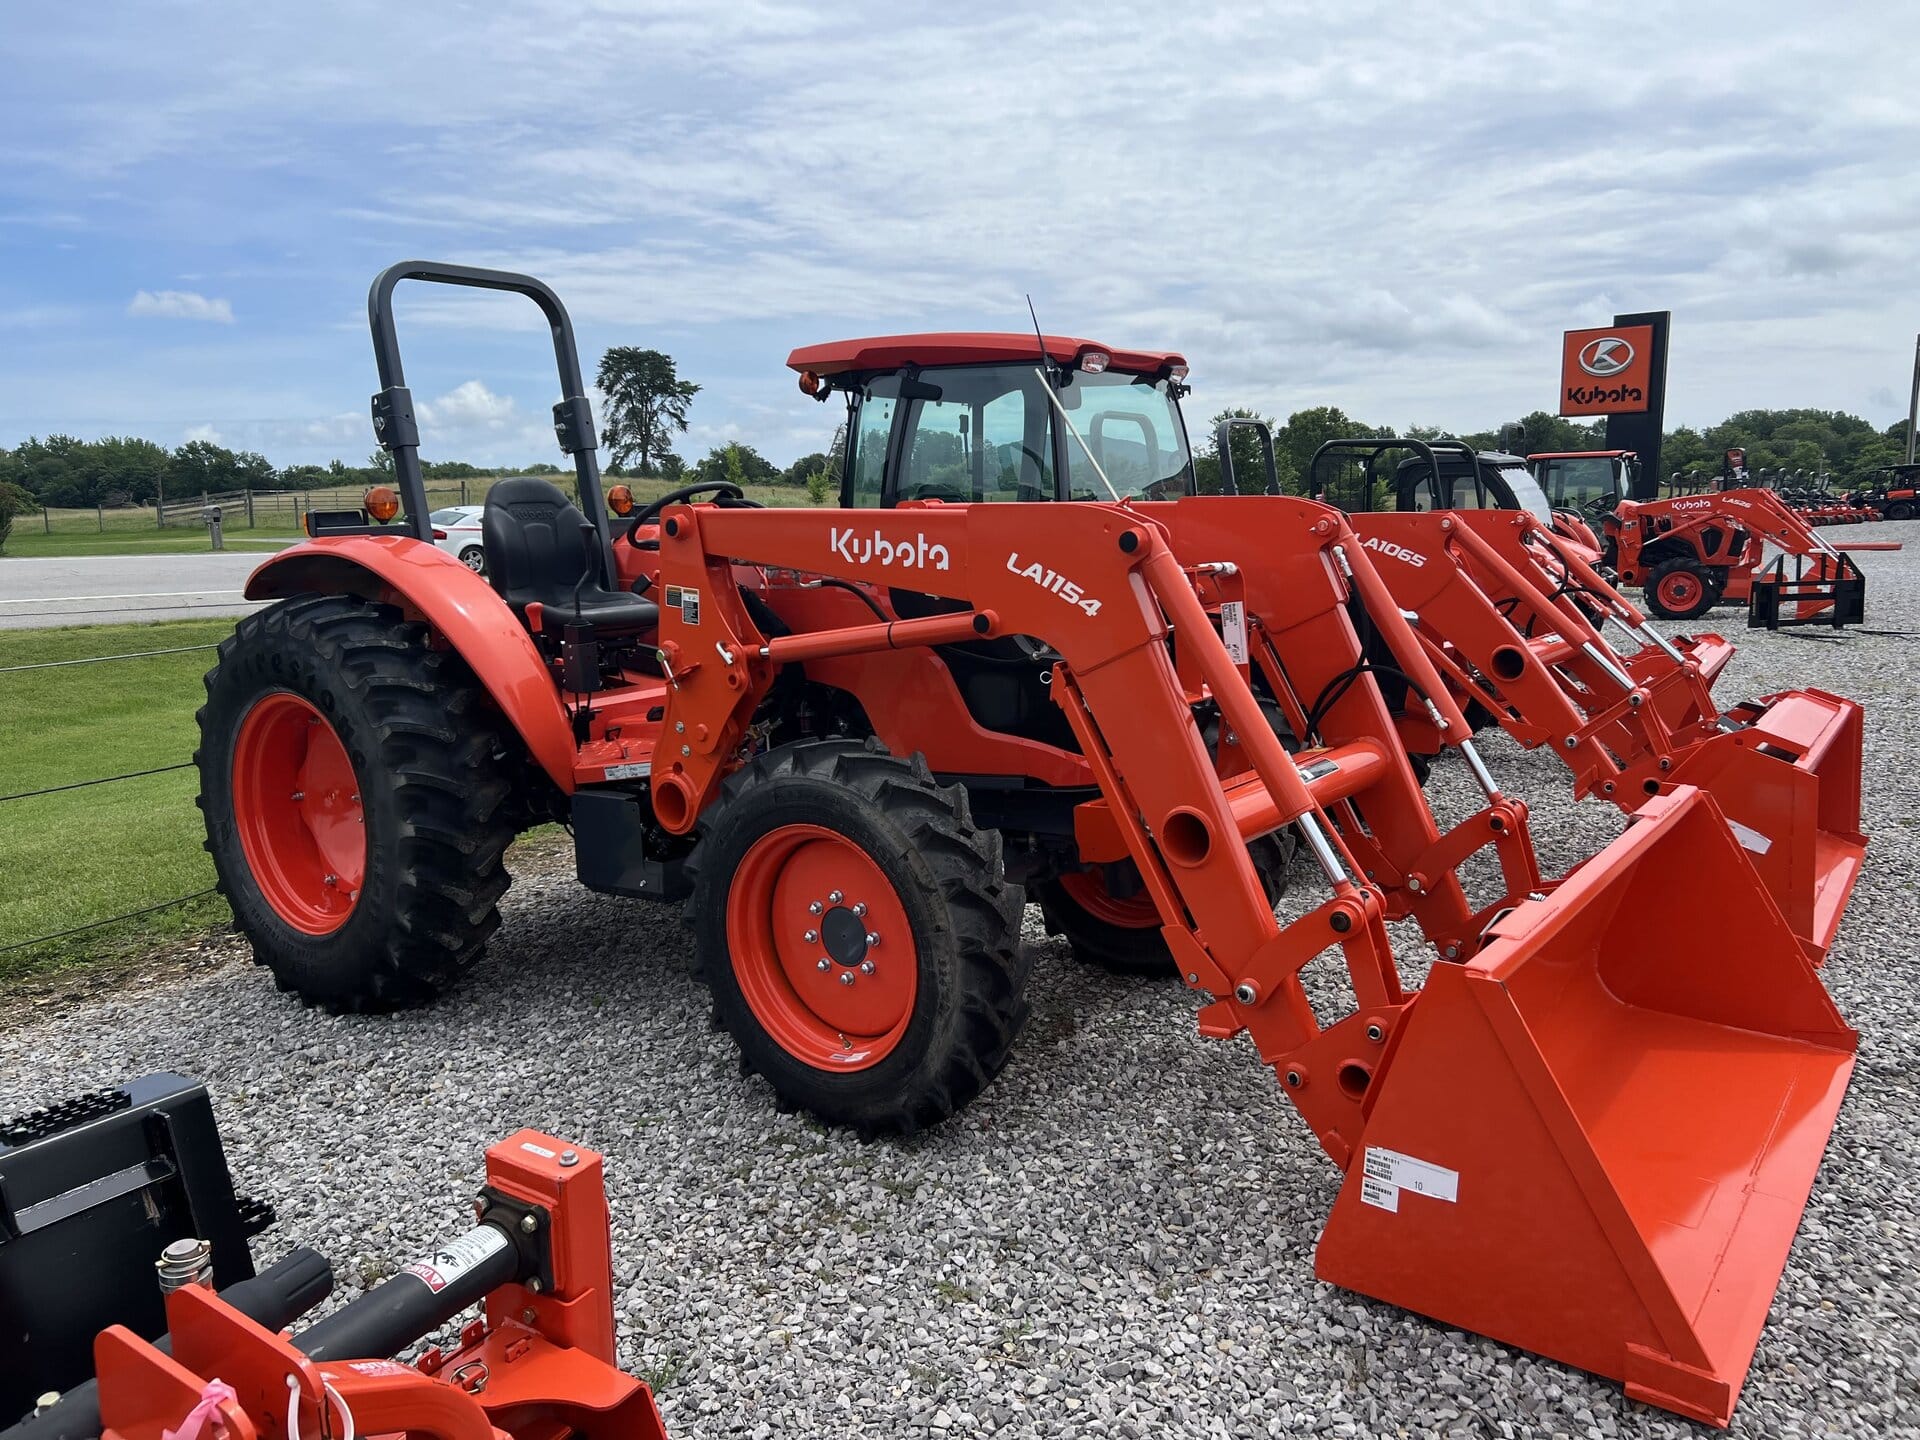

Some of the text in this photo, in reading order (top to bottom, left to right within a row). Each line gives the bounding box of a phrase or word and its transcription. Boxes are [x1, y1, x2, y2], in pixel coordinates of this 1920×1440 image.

[1567, 384, 1642, 405] Kubota
[1671, 499, 1711, 511] Kubota
[831, 527, 949, 571] Kubota
[1006, 552, 1103, 617] LA1154
[1414, 1180, 1423, 1191] 10
